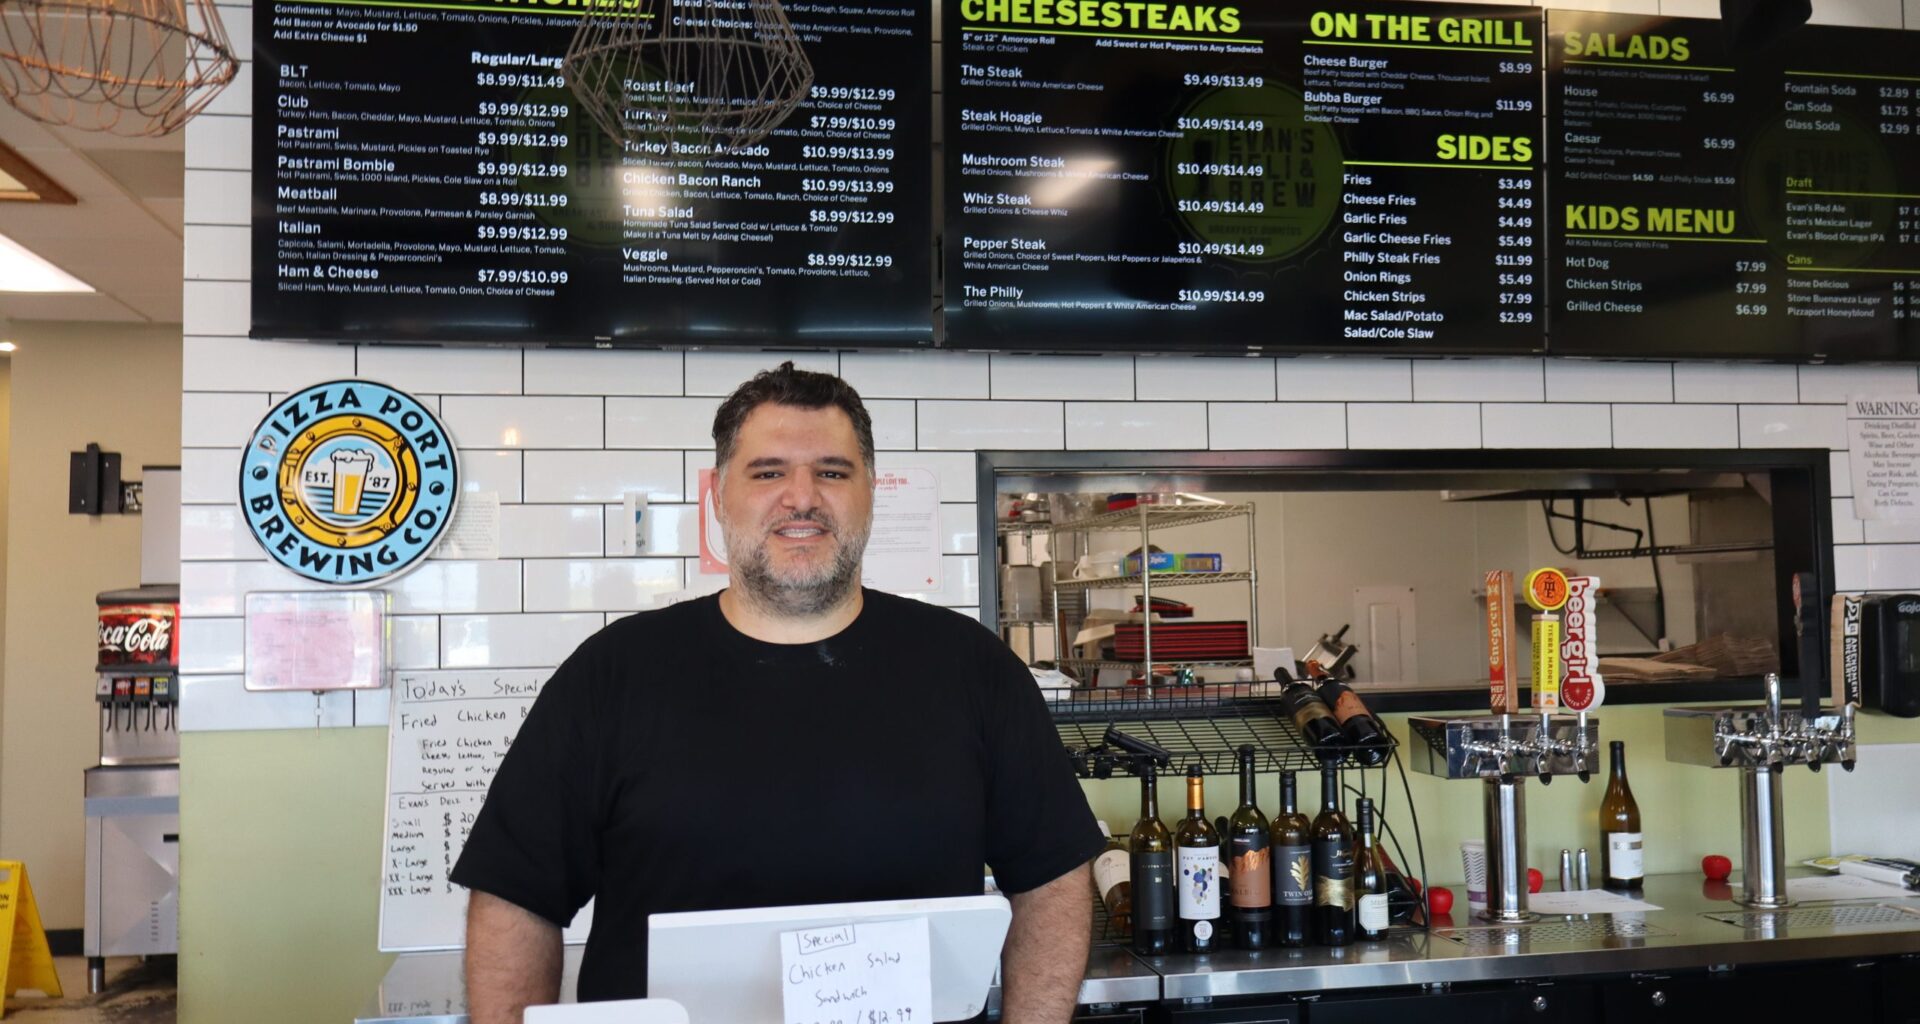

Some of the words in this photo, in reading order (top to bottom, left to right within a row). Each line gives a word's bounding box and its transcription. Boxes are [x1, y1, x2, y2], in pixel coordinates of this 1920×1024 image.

[273, 17, 292, 26] Add
[294, 18, 322, 28] Bacon
[336, 20, 376, 30] Avocado
[377, 22, 391, 31] for
[392, 22, 418, 32] $1.50
[961, 0, 1241, 33] CHEESESTEAKS
[1310, 12, 1357, 38] ON
[1365, 14, 1430, 41] THE
[1438, 17, 1532, 46] GRILL
[1095, 39, 1112, 47] Add
[1113, 40, 1139, 48] Sweet
[1149, 41, 1164, 49] Hot
[1165, 42, 1198, 51] Peppers
[1209, 44, 1225, 53] Any
[1226, 45, 1263, 53] Sandwich
[1563, 31, 1691, 62] SALADS
[1304, 54, 1347, 67] Cheese
[1349, 56, 1388, 70] Burger
[1499, 62, 1532, 74] $8.99
[280, 64, 308, 78] BLT
[477, 72, 565, 88] $8.99/$11.49
[961, 64, 984, 77] The
[987, 65, 1022, 78] Steak
[1184, 73, 1263, 88] $9.49/$13.49
[1304, 91, 1341, 103] Bubba
[1343, 92, 1382, 106] Burger
[1496, 99, 1532, 111] $11.99
[1564, 85, 1598, 97] House
[1703, 91, 1735, 103] $6.99
[278, 94, 309, 108] Club
[479, 102, 568, 117] $9.99/$12.99
[1785, 100, 1805, 111] Can
[1806, 101, 1833, 113] Soda
[1880, 105, 1909, 116] $1.75
[962, 109, 997, 122] Steak
[1000, 111, 1042, 125] Hoagie
[1178, 117, 1263, 131] $10.49/$14.49
[1785, 119, 1813, 130] Glass
[1815, 120, 1841, 131] Soda
[1880, 123, 1910, 134] $2.99
[278, 124, 339, 139] Pastrami
[478, 132, 568, 147] $9.99/$12.99
[1564, 132, 1601, 144] Caesar
[1704, 138, 1735, 149] $6.99
[1437, 134, 1532, 162] SIDES
[278, 155, 339, 170] Pastrami
[478, 162, 567, 177] $9.99/$12.99
[962, 153, 1027, 167] Mushroom
[1030, 155, 1065, 168] Steak
[1177, 162, 1263, 176] $10.49/$14.49
[622, 173, 675, 185] Chicken
[678, 173, 718, 186] Bacon
[722, 175, 761, 187] Ranch
[802, 178, 894, 193] $10.99/$13.99
[1343, 173, 1372, 185] Fries
[1498, 178, 1532, 190] $3.49
[1786, 176, 1812, 188] Draft
[278, 186, 337, 200] Meatball
[480, 192, 568, 207] $8.99/$11.99
[963, 192, 994, 204] Whiz
[996, 193, 1032, 206] Steak
[1178, 200, 1264, 213] $10.49/$14.49
[1343, 193, 1386, 205] Cheese
[1388, 194, 1416, 206] Fries
[1498, 197, 1532, 209] $4.49
[623, 205, 655, 218] Tuna
[657, 206, 693, 219] Salad
[810, 209, 894, 223] $8.99/$12.99
[1343, 212, 1376, 224] Garlic
[1379, 213, 1407, 225] Fries
[1499, 216, 1532, 228] $4.49
[1566, 204, 1640, 231] KIDS
[1647, 208, 1735, 234] MENU
[279, 220, 321, 234] Italian
[478, 225, 567, 240] $9.99/$12.99
[1343, 231, 1376, 243] Garlic
[1379, 232, 1421, 244] Cheese
[1423, 234, 1451, 245] Fries
[1498, 235, 1532, 247] $5.49
[964, 237, 1008, 250] Pepper
[1011, 238, 1046, 250] Steak
[1178, 242, 1264, 255] $10.49/$14.49
[622, 248, 668, 262] Veggie
[808, 253, 892, 267] $8.99/$12.99
[1344, 251, 1375, 264] Philly
[1377, 252, 1410, 263] Steak
[1412, 252, 1440, 264] Fries
[1495, 254, 1533, 266] $11.99
[1566, 256, 1585, 267] Hot
[1588, 257, 1609, 270] Dog
[1736, 261, 1767, 272] $7.99
[1787, 254, 1813, 265] Cans
[278, 264, 309, 277] Ham
[313, 265, 324, 278] &
[328, 265, 379, 279] Cheese
[478, 269, 568, 283] $7.99/$10.99
[623, 274, 647, 283] Italian
[685, 275, 715, 285] (Served
[716, 276, 730, 285] Hot
[741, 277, 761, 286] Cold)
[1344, 270, 1377, 282] Onion
[1379, 271, 1411, 285] Rings
[1499, 273, 1533, 285] $5.49
[963, 285, 987, 297] The
[990, 286, 1023, 300] Philly
[1179, 289, 1264, 303] $10.99/$14.99
[1566, 278, 1609, 290] Chicken
[1611, 279, 1642, 292] Strips
[1736, 282, 1767, 294] $7.99
[1344, 290, 1390, 302] Chicken
[1392, 291, 1426, 304] Strips
[1499, 292, 1532, 304] $7.99
[1344, 310, 1368, 321] Mac
[1370, 309, 1444, 322] Salad/Potato
[1499, 311, 1533, 323] $2.99
[1566, 300, 1601, 312] Grilled
[1603, 301, 1643, 313] Cheese
[1736, 304, 1767, 315] $6.99
[1344, 327, 1405, 338] Salad/Cole
[1407, 327, 1434, 339] Slaw
[257, 387, 362, 457] PIZZA
[379, 394, 449, 472] PORT
[304, 471, 331, 484] EST.
[369, 476, 391, 489] '87
[249, 493, 400, 577] BREWING
[403, 505, 442, 546] CO.
[98, 618, 172, 653] oca-Cola
[1561, 579, 1590, 684] beergirl
[401, 678, 466, 700] Today's
[493, 677, 538, 695] Special
[401, 714, 437, 731] Fried
[457, 709, 506, 722] Chicken
[803, 927, 849, 949] Special
[789, 961, 846, 985] Chicken
[867, 951, 901, 969] Salad
